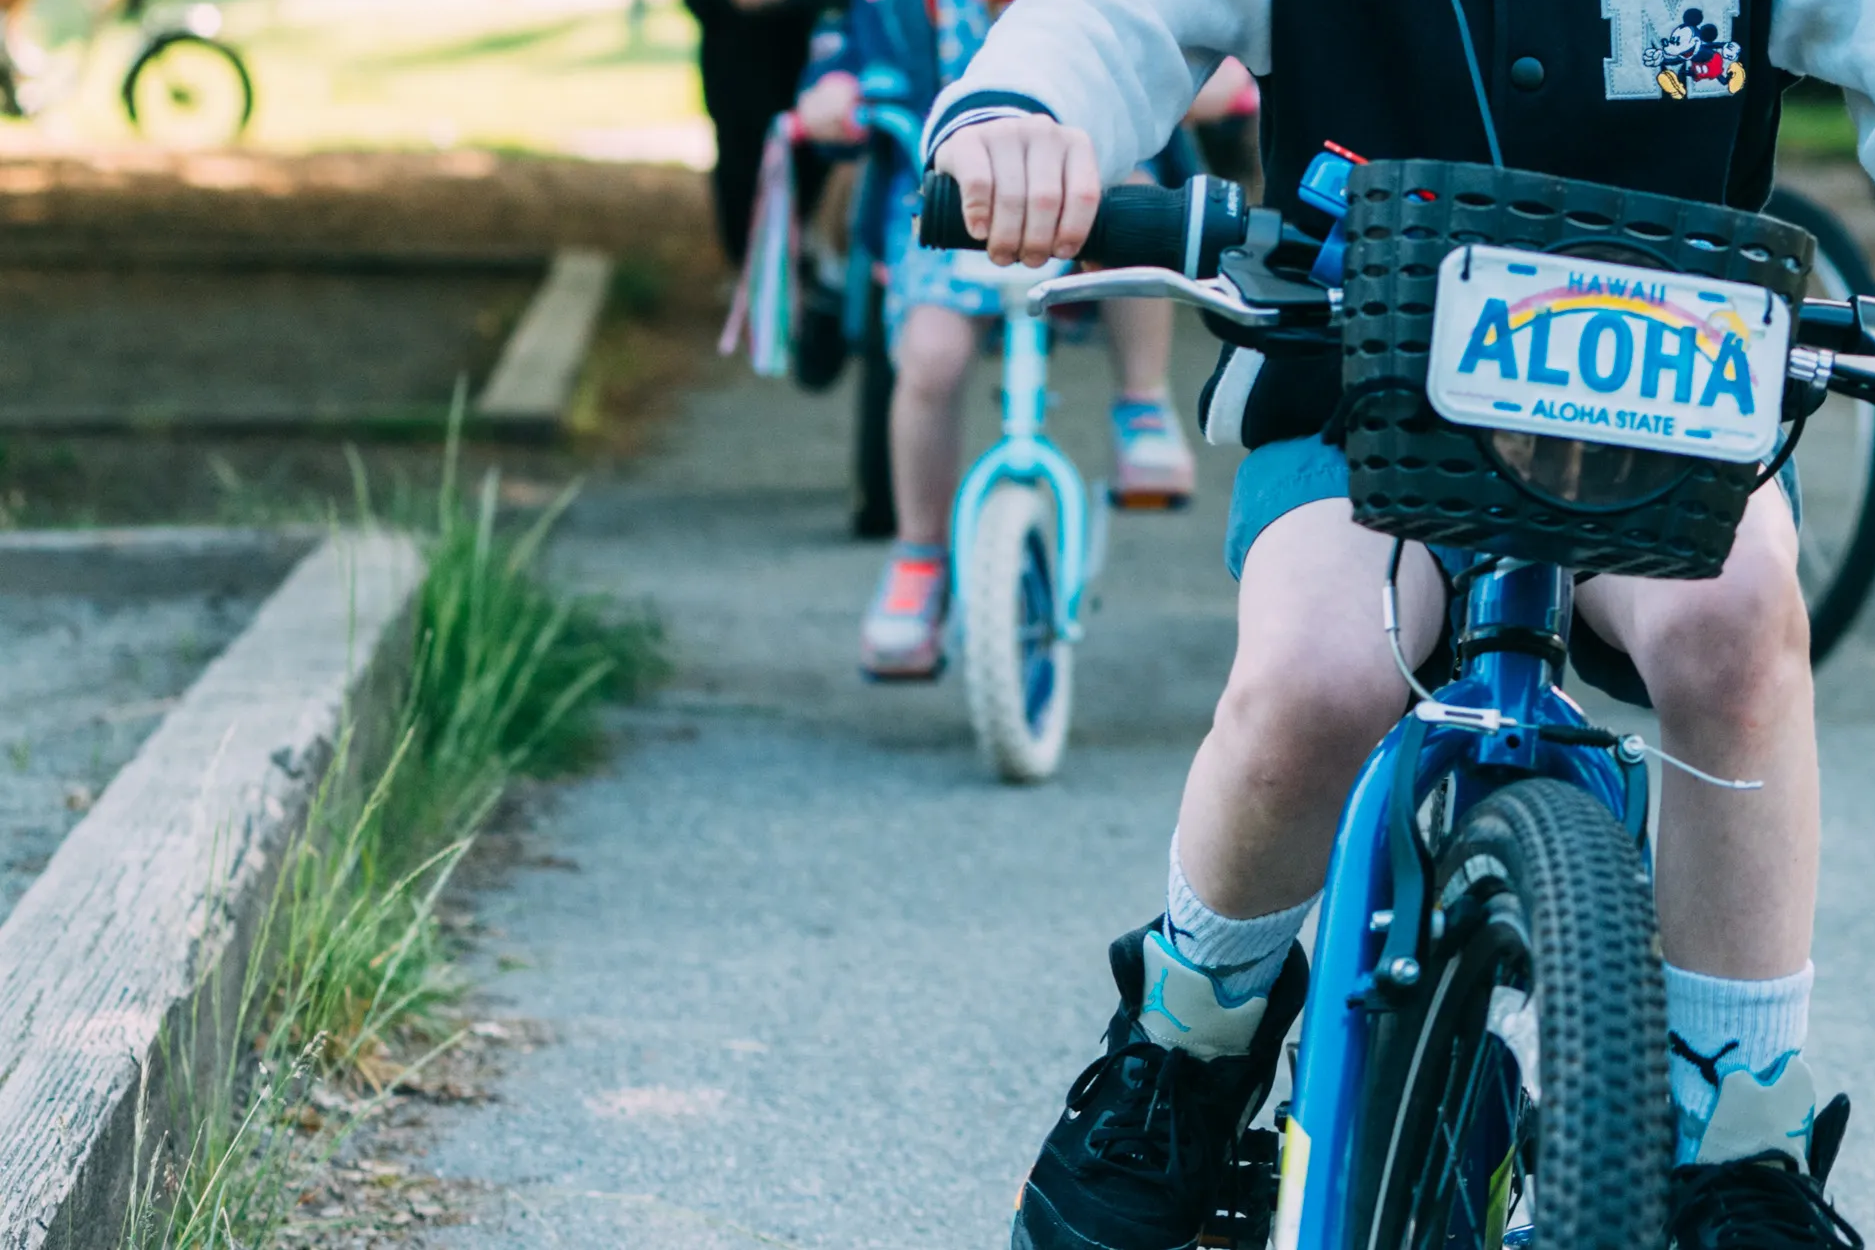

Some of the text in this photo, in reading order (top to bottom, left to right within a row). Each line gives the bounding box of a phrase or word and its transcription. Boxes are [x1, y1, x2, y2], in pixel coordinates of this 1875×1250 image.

[1568, 271, 1667, 304] HAWAII
[1457, 298, 1755, 416] ALOHA
[1531, 399, 1676, 437] ALOHA STATE
